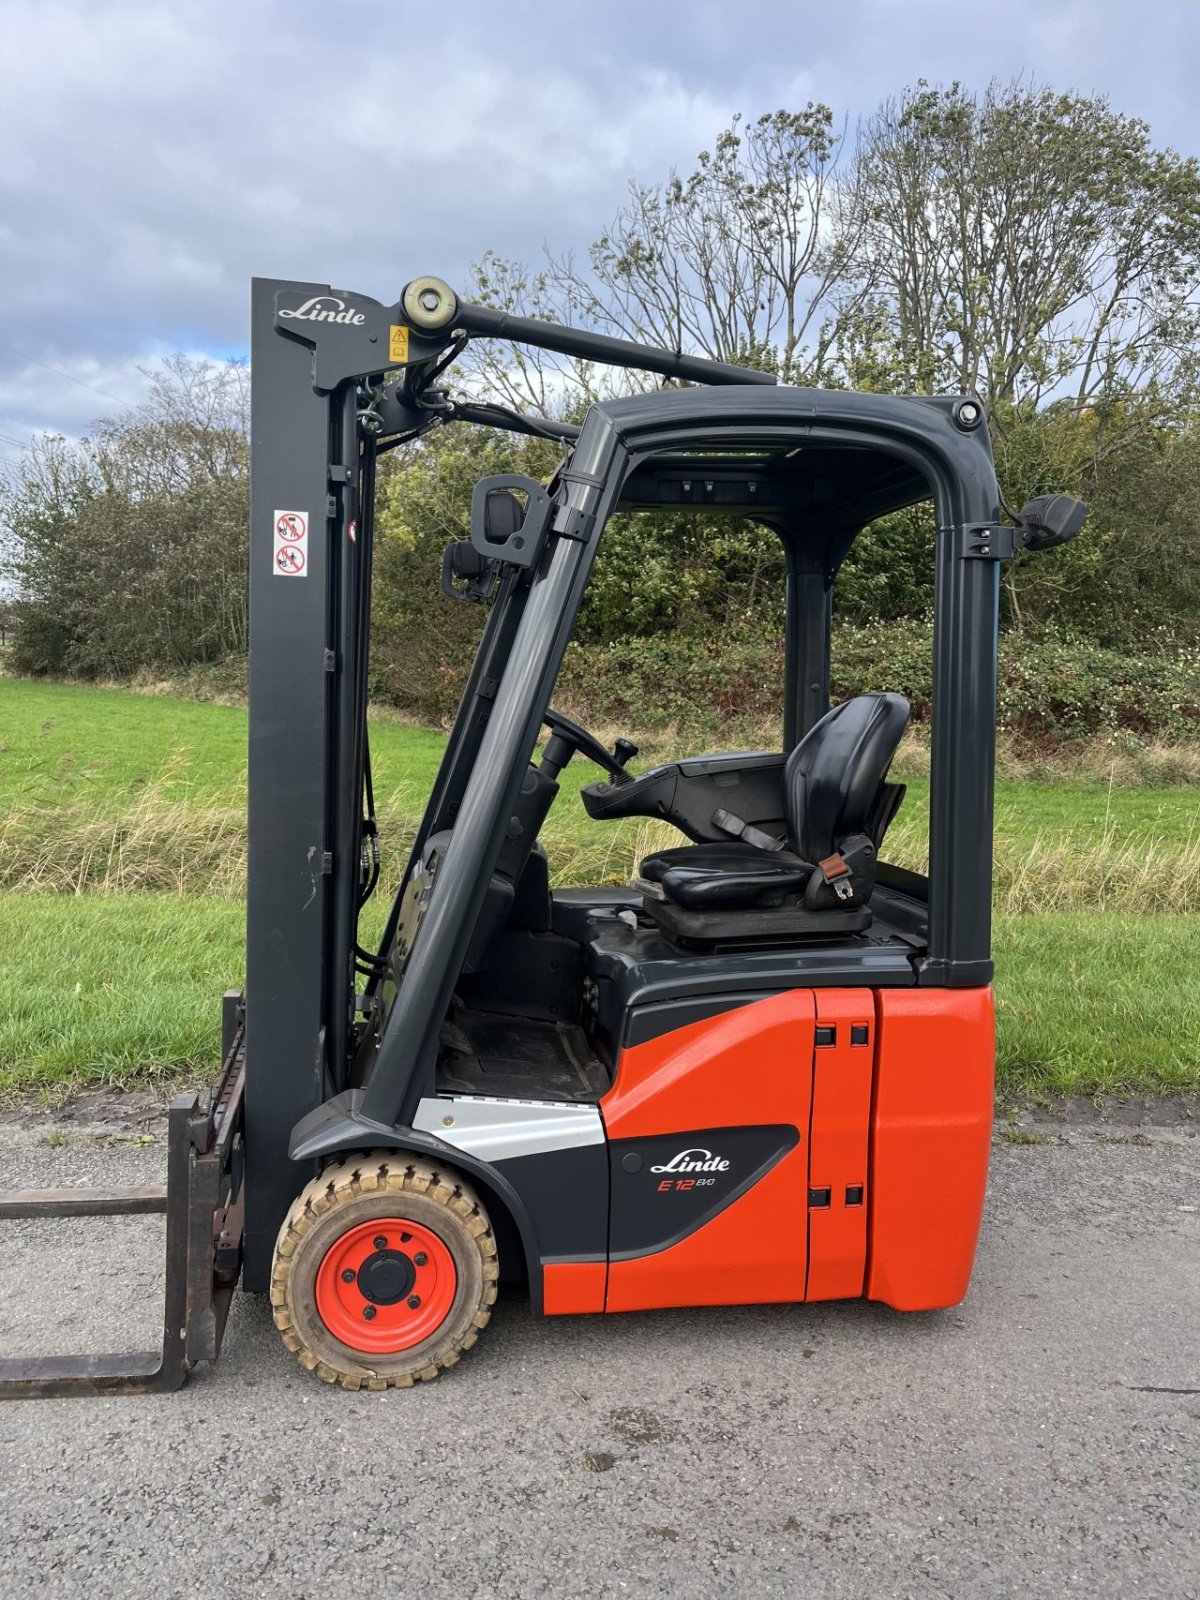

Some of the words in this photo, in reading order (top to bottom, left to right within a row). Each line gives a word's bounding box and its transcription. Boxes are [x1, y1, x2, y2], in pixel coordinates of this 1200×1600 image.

[278, 296, 366, 325] Linde
[650, 1148, 730, 1173] Linde
[657, 1180, 673, 1192] E
[675, 1179, 696, 1191] 12
[696, 1178, 716, 1186] EVO
